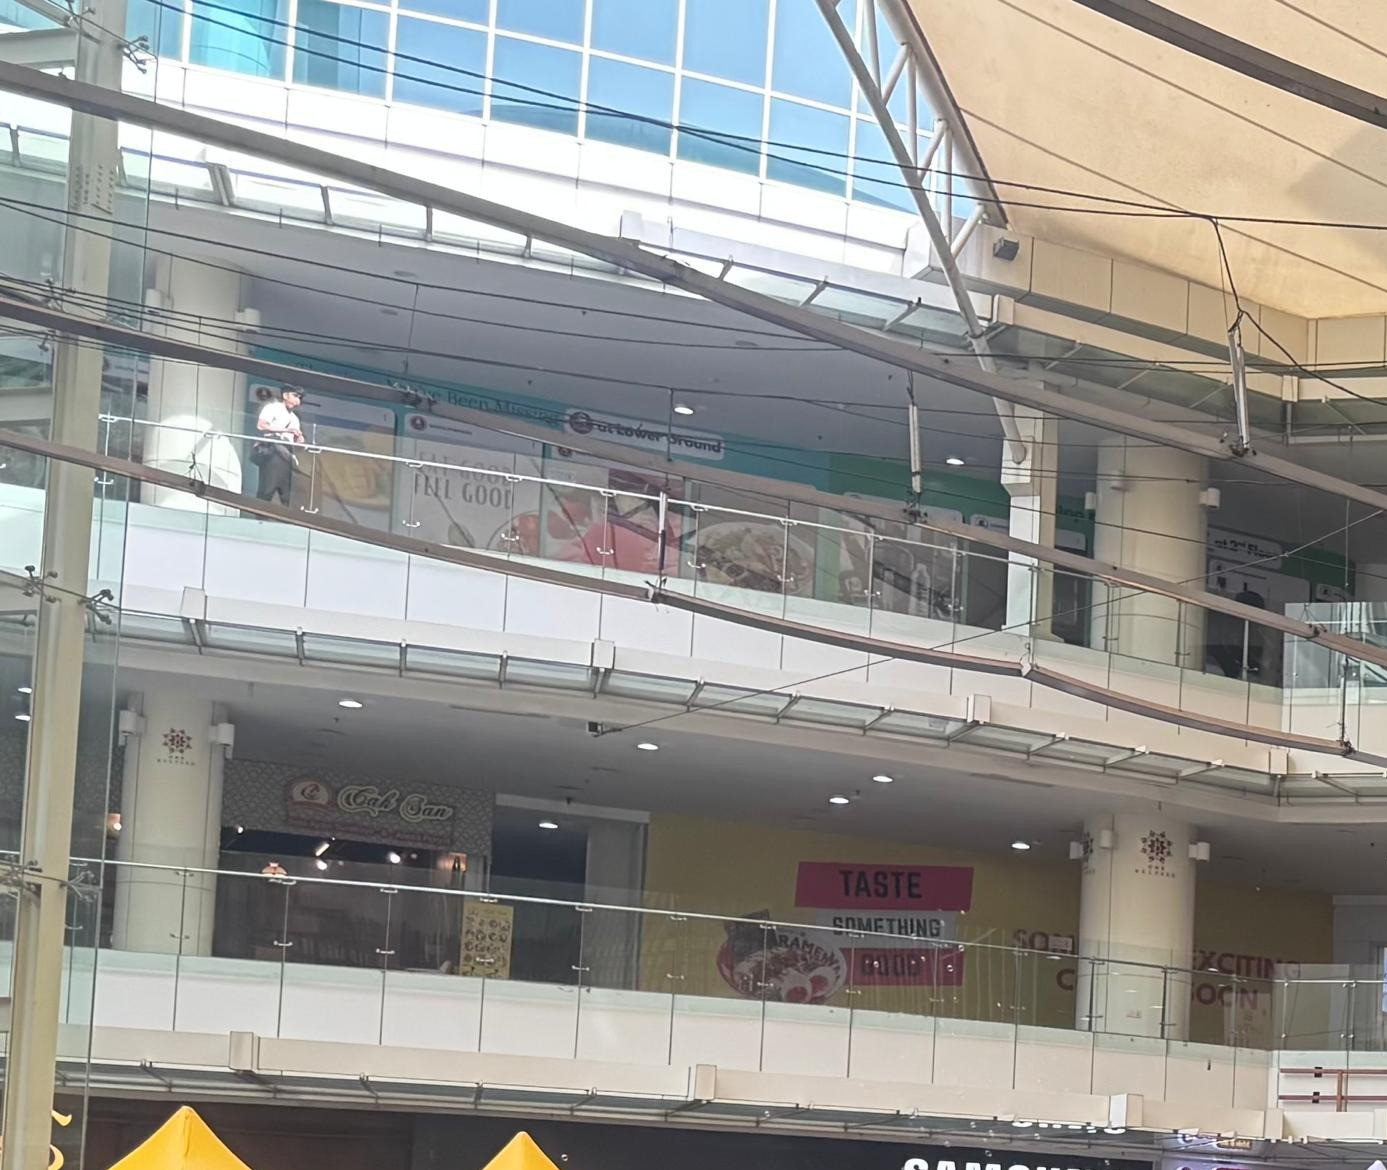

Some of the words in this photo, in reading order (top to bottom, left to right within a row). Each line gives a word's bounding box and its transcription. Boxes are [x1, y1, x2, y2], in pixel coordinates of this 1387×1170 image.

[839, 869, 922, 900] TASTE
[832, 915, 941, 938] SOMETHING
[861, 953, 921, 978] GOOD
